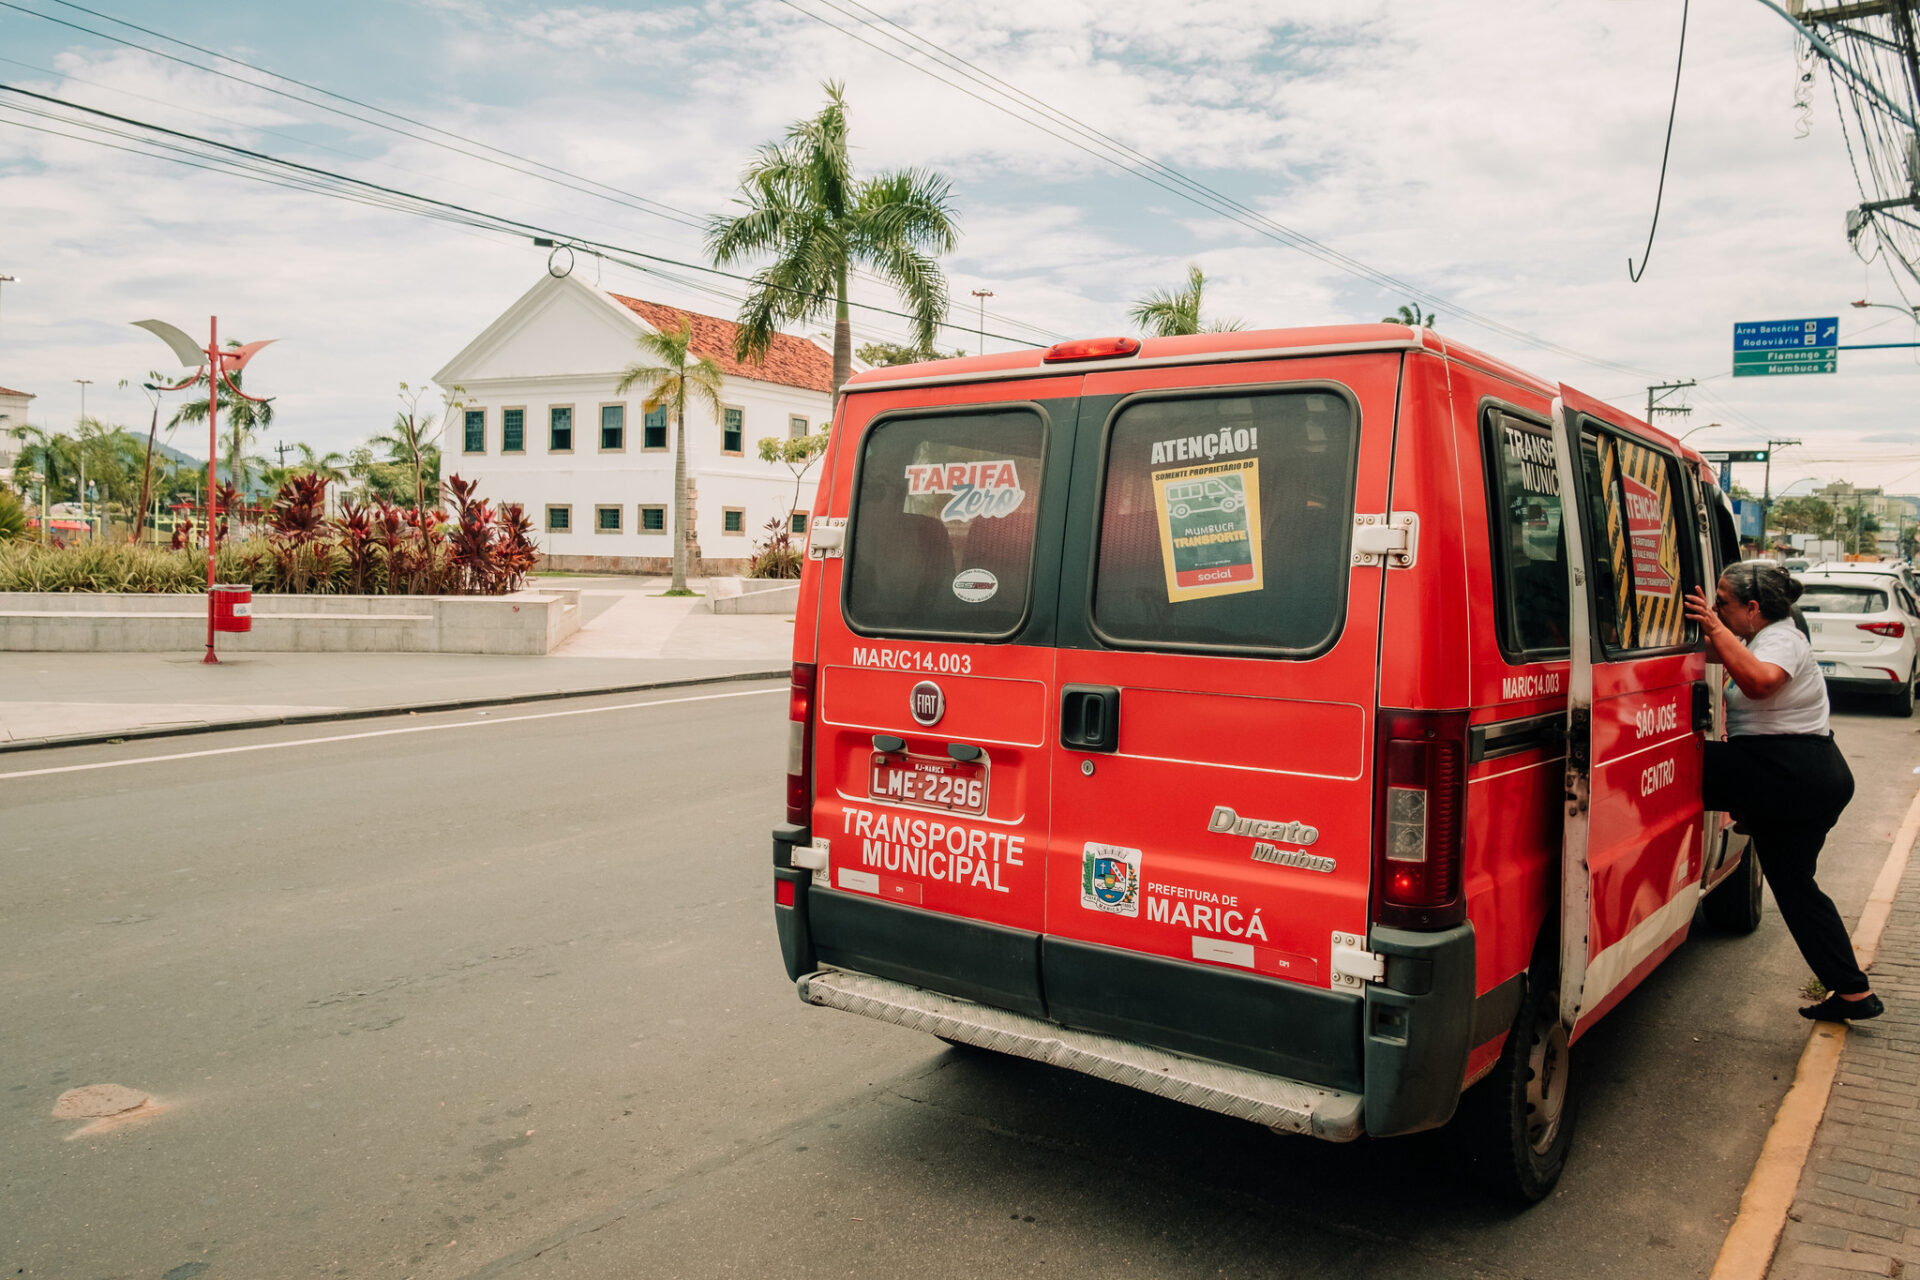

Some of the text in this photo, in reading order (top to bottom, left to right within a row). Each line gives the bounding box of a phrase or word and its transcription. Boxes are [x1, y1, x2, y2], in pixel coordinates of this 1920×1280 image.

[1736, 324, 1799, 334] Área Bancária
[1743, 337, 1799, 346] Rodoviária
[1768, 352, 1820, 361] Flamengo
[1768, 365, 1819, 373] Mumbuca
[1151, 427, 1258, 465] ATENÇÃO!
[908, 463, 1017, 491] TARIFA
[1155, 461, 1254, 481] SOMENTE PROPRIETÁRIO DO
[944, 484, 1019, 518] Zero
[1173, 530, 1248, 548] TRANSPORTE
[1184, 522, 1234, 536] MUMBUCA
[1198, 569, 1232, 581] social
[852, 647, 972, 674] MAR/C14.003
[1503, 673, 1559, 700] MAR/C14.003
[917, 694, 937, 715] FIAT
[1636, 696, 1677, 739] SÃO JOSÉ
[1641, 757, 1675, 797] CENTRO
[842, 807, 1025, 866] TRANSPORTE
[1208, 806, 1319, 846] Ducato
[862, 838, 1010, 893] MUNICIPAL
[1251, 842, 1336, 873] Minibus
[1148, 882, 1238, 907] PREFEITURA DE
[1147, 896, 1268, 942] MARICÁ
